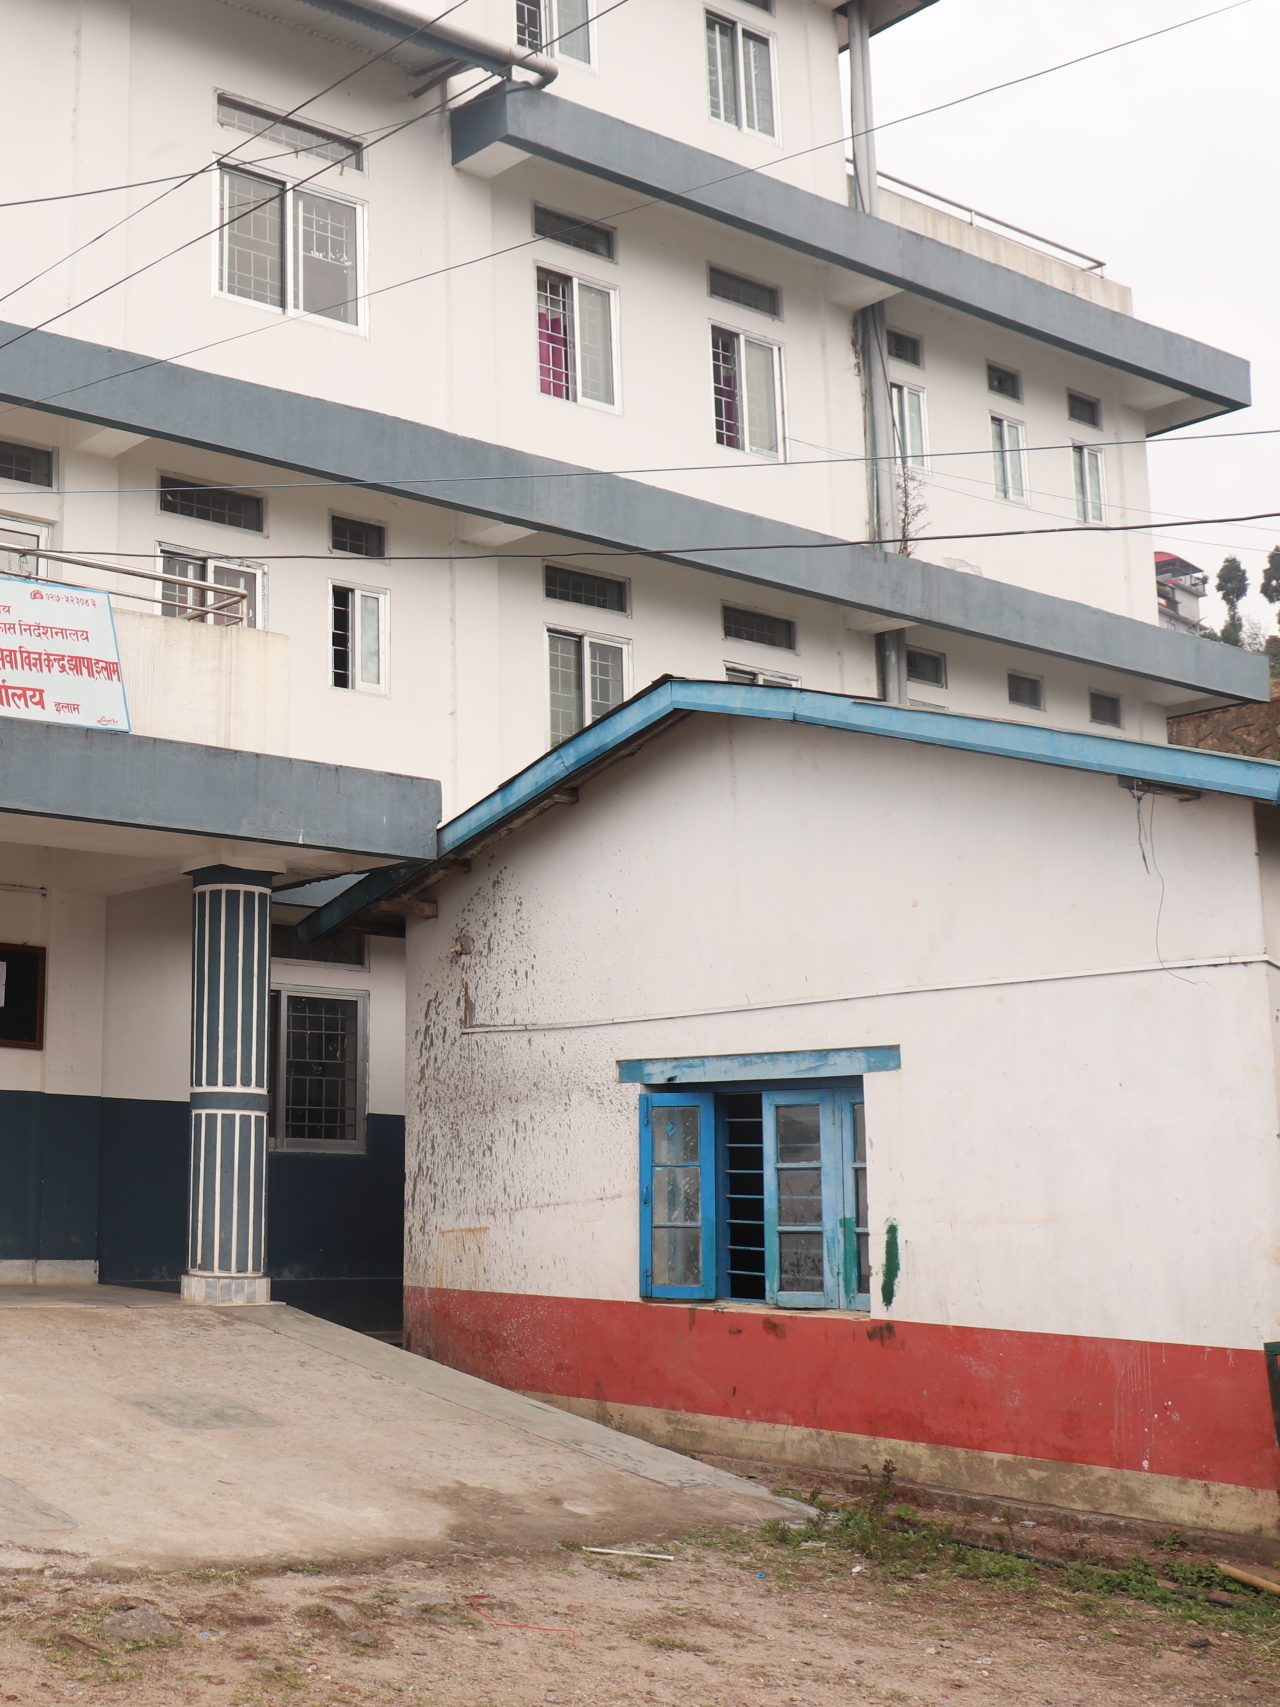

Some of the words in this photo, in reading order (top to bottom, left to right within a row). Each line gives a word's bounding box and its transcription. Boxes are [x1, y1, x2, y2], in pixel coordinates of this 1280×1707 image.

[18, 645, 43, 673] विज्ञ
[43, 649, 69, 675] केन्द्र
[94, 658, 121, 682] इलाम
[54, 701, 81, 715] इलाम
